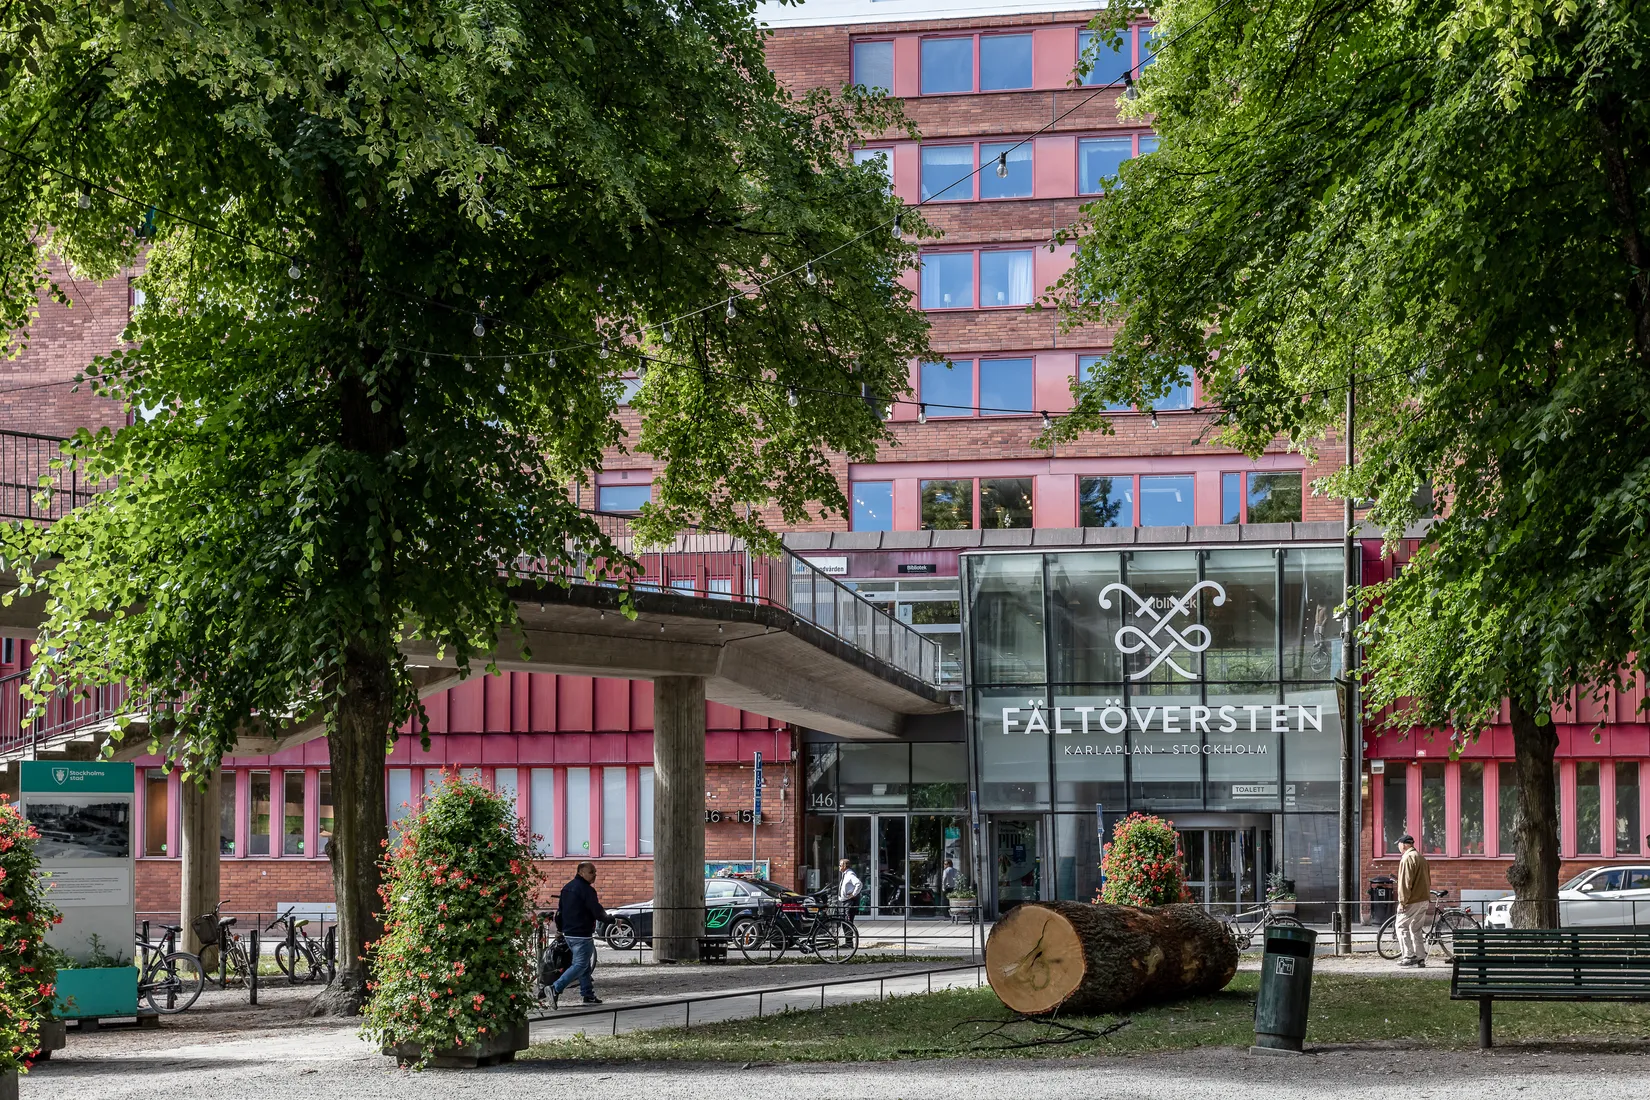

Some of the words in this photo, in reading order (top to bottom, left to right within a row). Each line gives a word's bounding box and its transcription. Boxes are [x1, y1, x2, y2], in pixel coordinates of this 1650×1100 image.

[1001, 699, 1323, 735] FÄLTÖVERSTEN
[1064, 745, 1153, 756] KARLAPLAN
[1172, 744, 1268, 755] STOCKHOLM
[811, 792, 833, 807] 146
